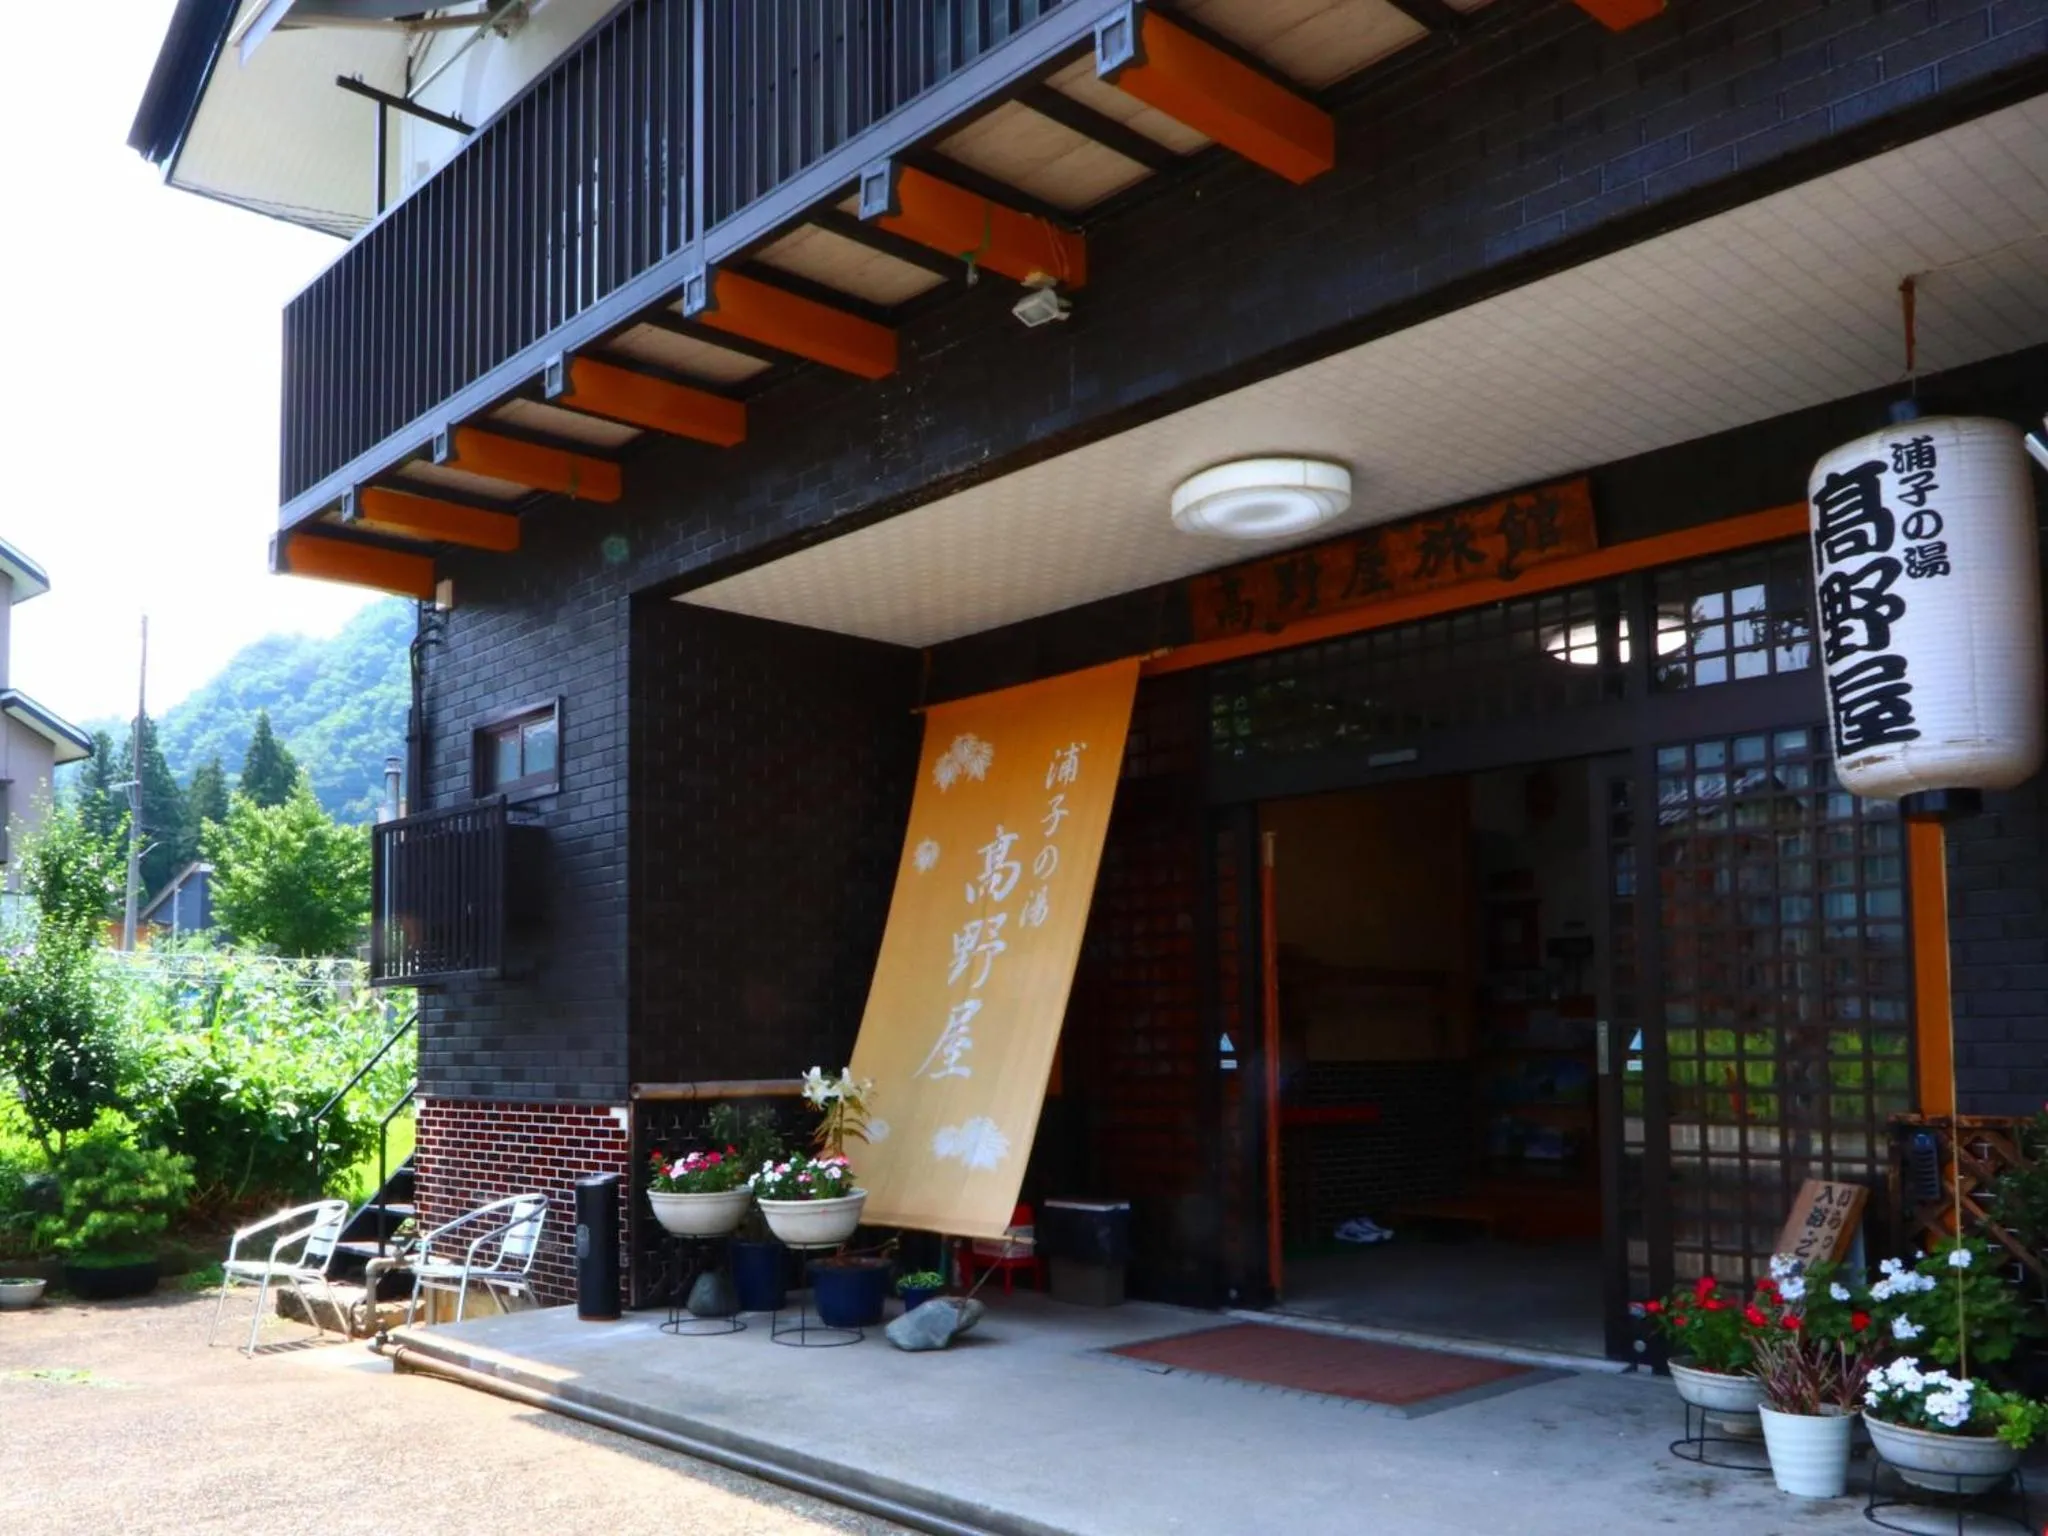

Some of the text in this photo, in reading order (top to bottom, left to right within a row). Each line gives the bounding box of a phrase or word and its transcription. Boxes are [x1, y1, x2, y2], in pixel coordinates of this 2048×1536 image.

[1890, 434, 1951, 580] 浦子の湯
[1018, 742, 1088, 929] 浦子の湯
